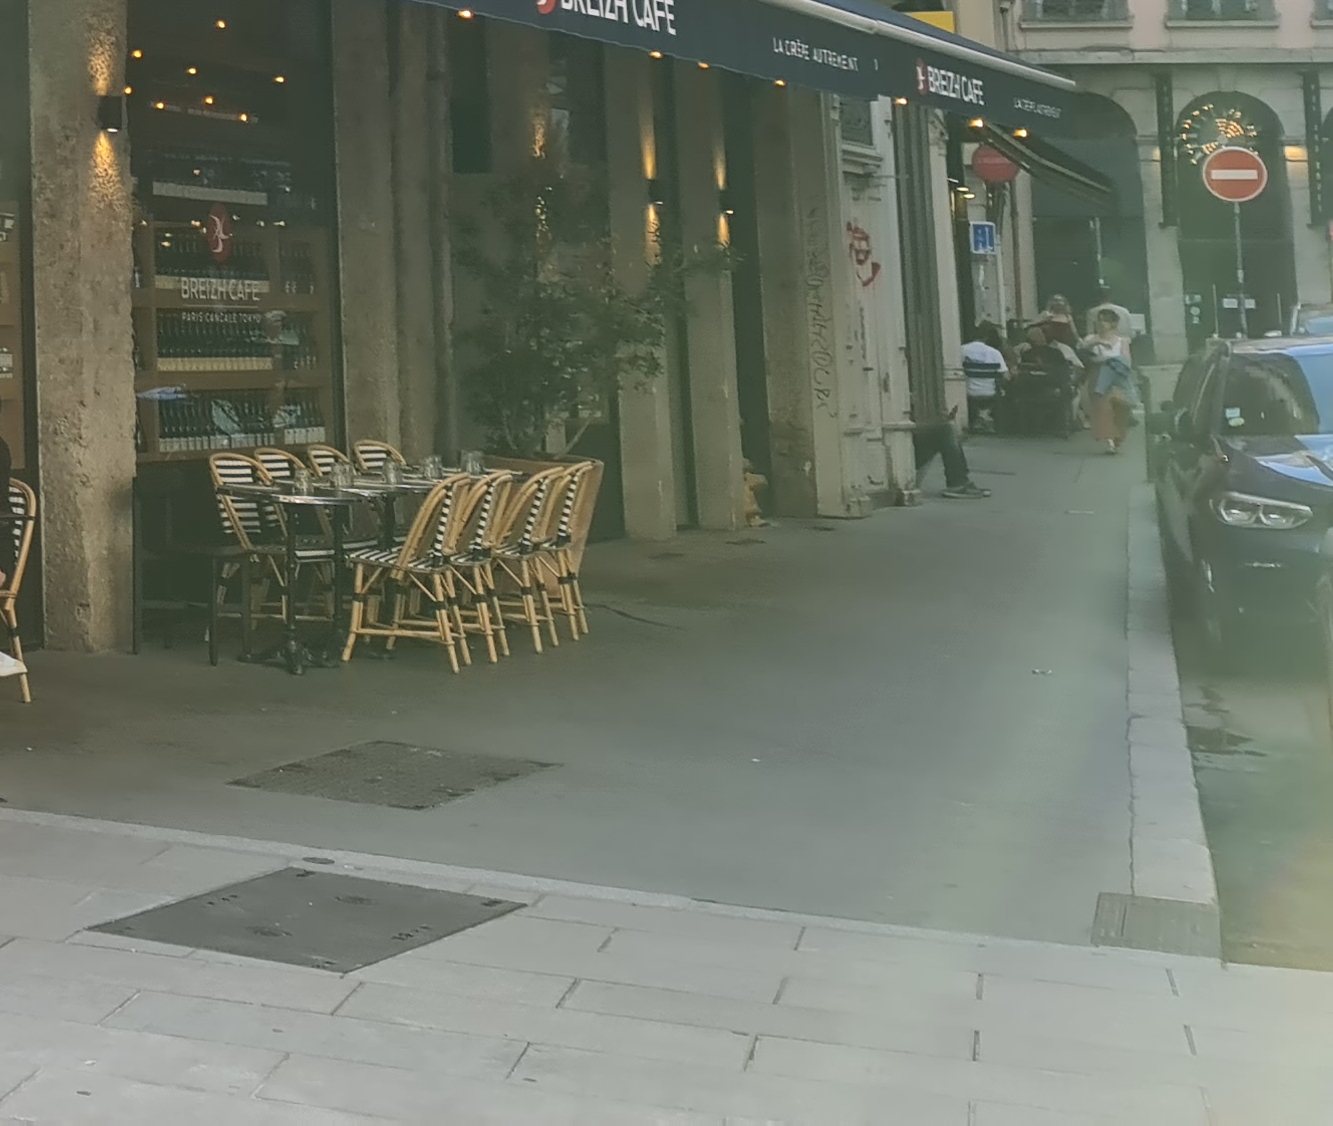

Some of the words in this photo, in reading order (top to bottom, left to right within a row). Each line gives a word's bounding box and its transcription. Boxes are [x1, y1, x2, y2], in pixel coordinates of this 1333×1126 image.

[772, 36, 783, 54] LA
[813, 47, 859, 72] AUTREMENT
[961, 74, 985, 106] CAFE
[180, 277, 227, 300] BREIZH
[228, 279, 261, 302] CAFE
